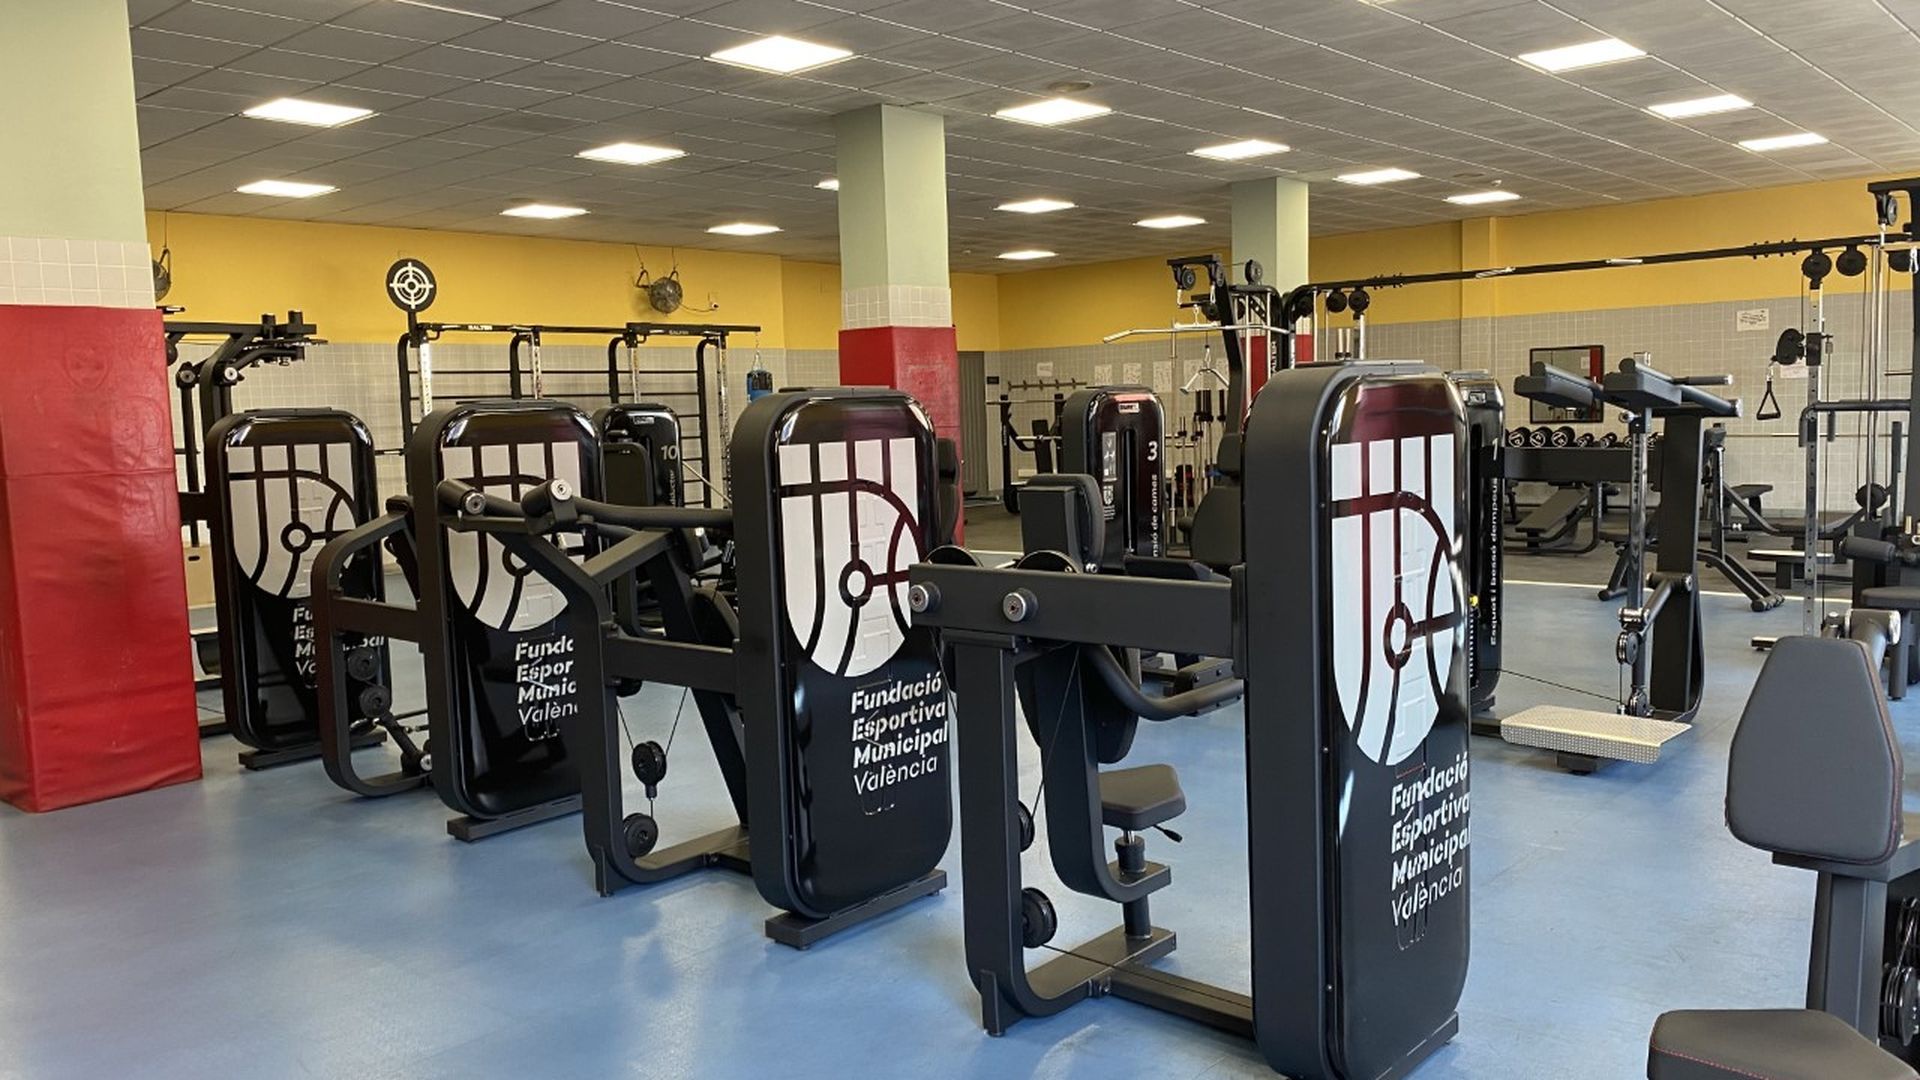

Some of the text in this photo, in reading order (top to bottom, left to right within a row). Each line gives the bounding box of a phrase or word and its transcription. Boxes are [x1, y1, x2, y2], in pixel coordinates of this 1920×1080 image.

[660, 445, 679, 460] 10
[1147, 441, 1158, 461] 3
[1151, 515, 1159, 530] de
[515, 635, 574, 661] Funda
[516, 660, 574, 683] Espor
[518, 677, 577, 704] Munic
[518, 701, 577, 725] Valèn
[851, 671, 942, 714] Fundació
[851, 700, 946, 742] Esportiva
[853, 720, 949, 768] Municipal
[854, 754, 938, 795] València
[1391, 751, 1468, 816] Fundació
[1391, 791, 1470, 853] Esportiva
[1391, 816, 1471, 891] Municipal
[1391, 865, 1463, 926] València
